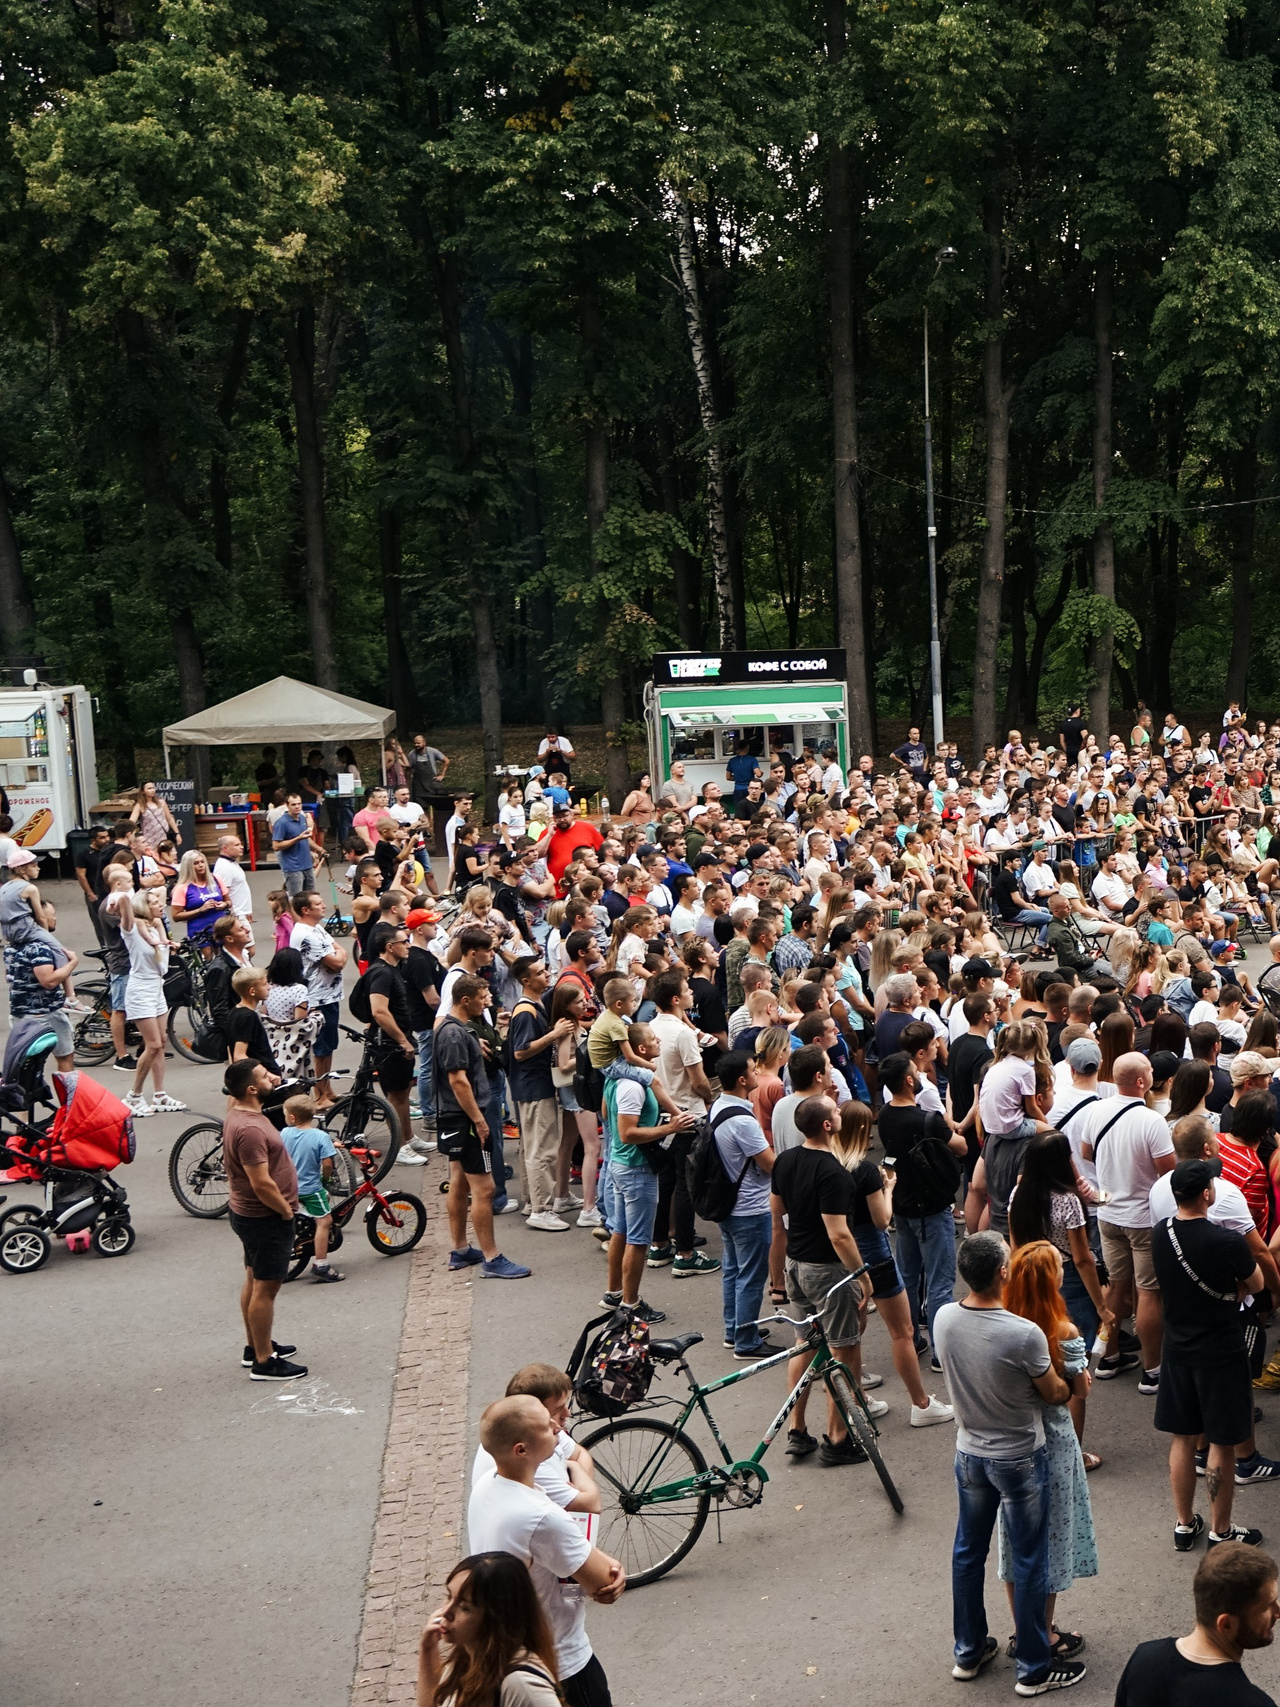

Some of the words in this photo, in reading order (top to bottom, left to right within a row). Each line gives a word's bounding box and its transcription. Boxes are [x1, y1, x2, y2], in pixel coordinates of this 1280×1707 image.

[748, 661, 780, 672] КОФЕ
[781, 660, 789, 671] С
[791, 658, 827, 671] СОБОЙ
[155, 780, 194, 791] АССИЧЕСКИЙ
[8, 797, 50, 806] ОРОЖЕНОЕ
[168, 803, 192, 812] УРГЕР
